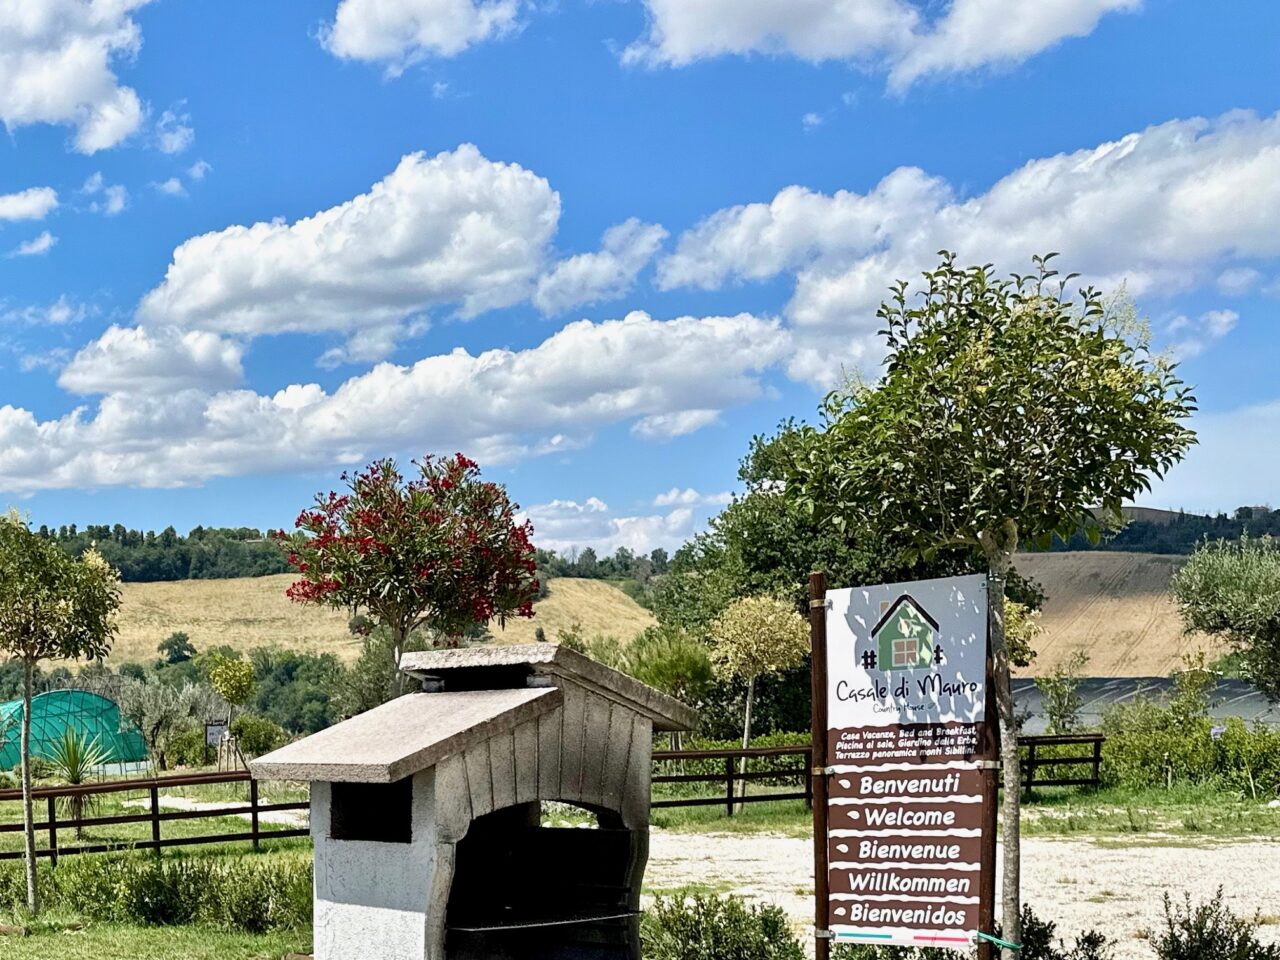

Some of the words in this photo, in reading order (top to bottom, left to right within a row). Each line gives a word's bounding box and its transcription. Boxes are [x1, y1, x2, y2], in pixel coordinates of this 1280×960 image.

[836, 680, 887, 702] Casale
[894, 677, 909, 698] di
[917, 674, 978, 697] Mauro
[836, 741, 863, 750] Piscina
[866, 740, 874, 749] al
[877, 740, 894, 750] sale,
[898, 738, 932, 748] Giardino
[841, 732, 860, 740] Casa
[862, 730, 896, 740] Vacanze,
[899, 729, 915, 738] Bed
[918, 728, 934, 736] and
[835, 751, 870, 760] Terrazzo
[872, 748, 916, 760] panoramica
[920, 747, 942, 756] monti
[860, 772, 960, 794] Benvenuti
[864, 806, 956, 826] Welcome
[858, 840, 960, 859] Bienvenue
[848, 872, 970, 893] Willkommen
[850, 903, 966, 926] Bienvenidos
